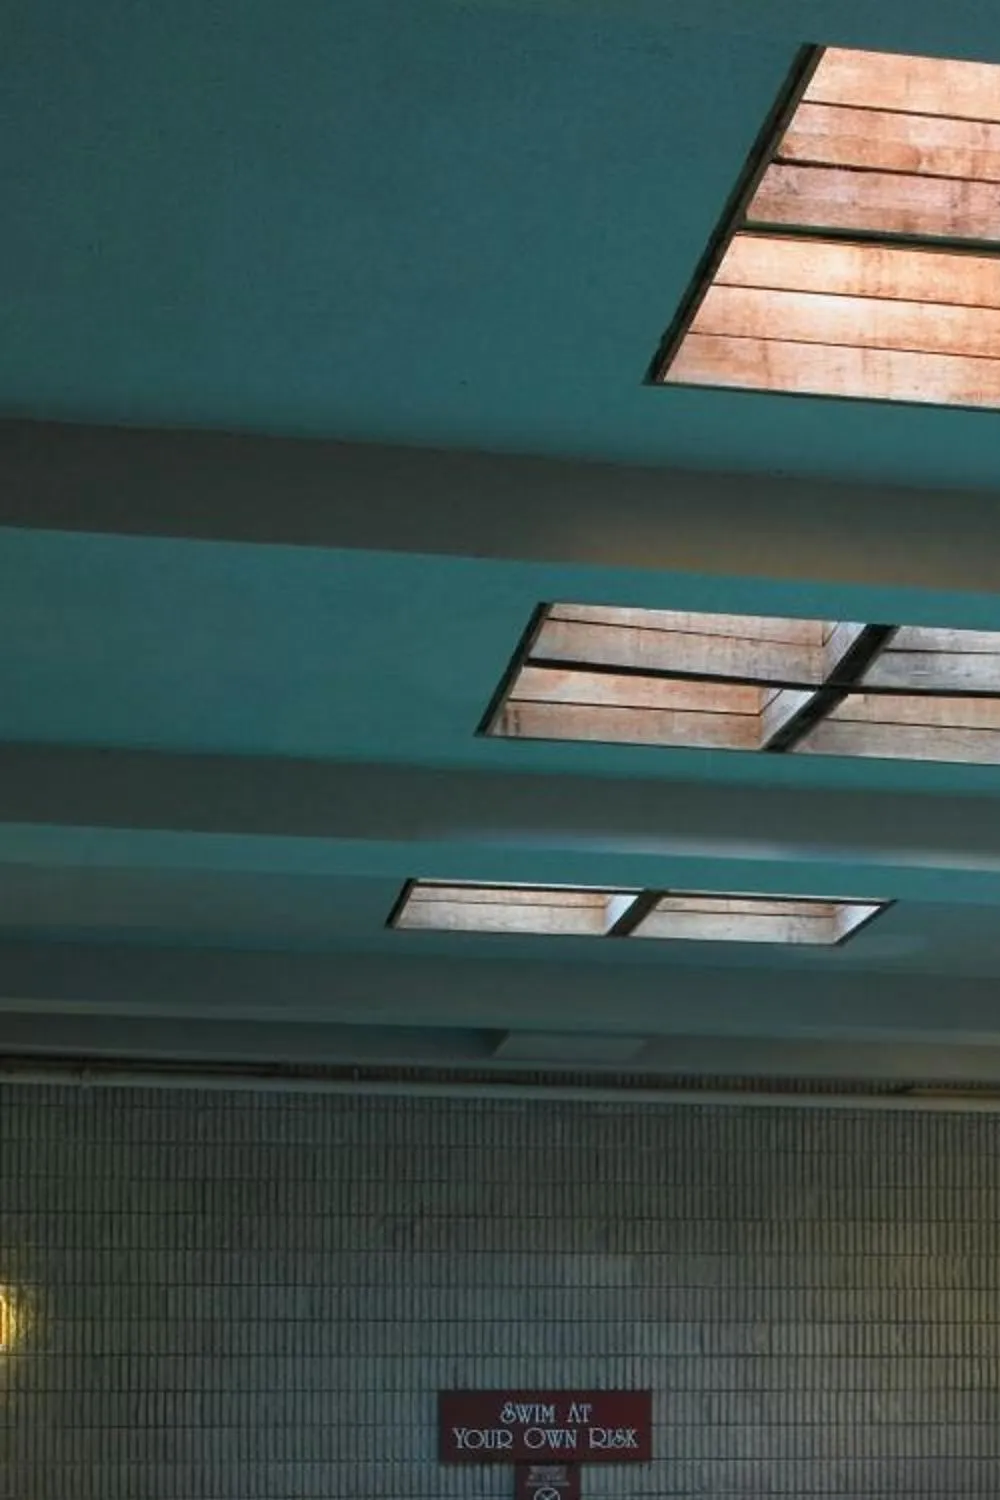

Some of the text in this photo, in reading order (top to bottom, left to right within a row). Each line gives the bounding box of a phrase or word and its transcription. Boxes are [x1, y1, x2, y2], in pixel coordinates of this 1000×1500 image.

[500, 1401, 592, 1424] SWIM AT
[452, 1427, 639, 1449] YOUR OWN RISK
